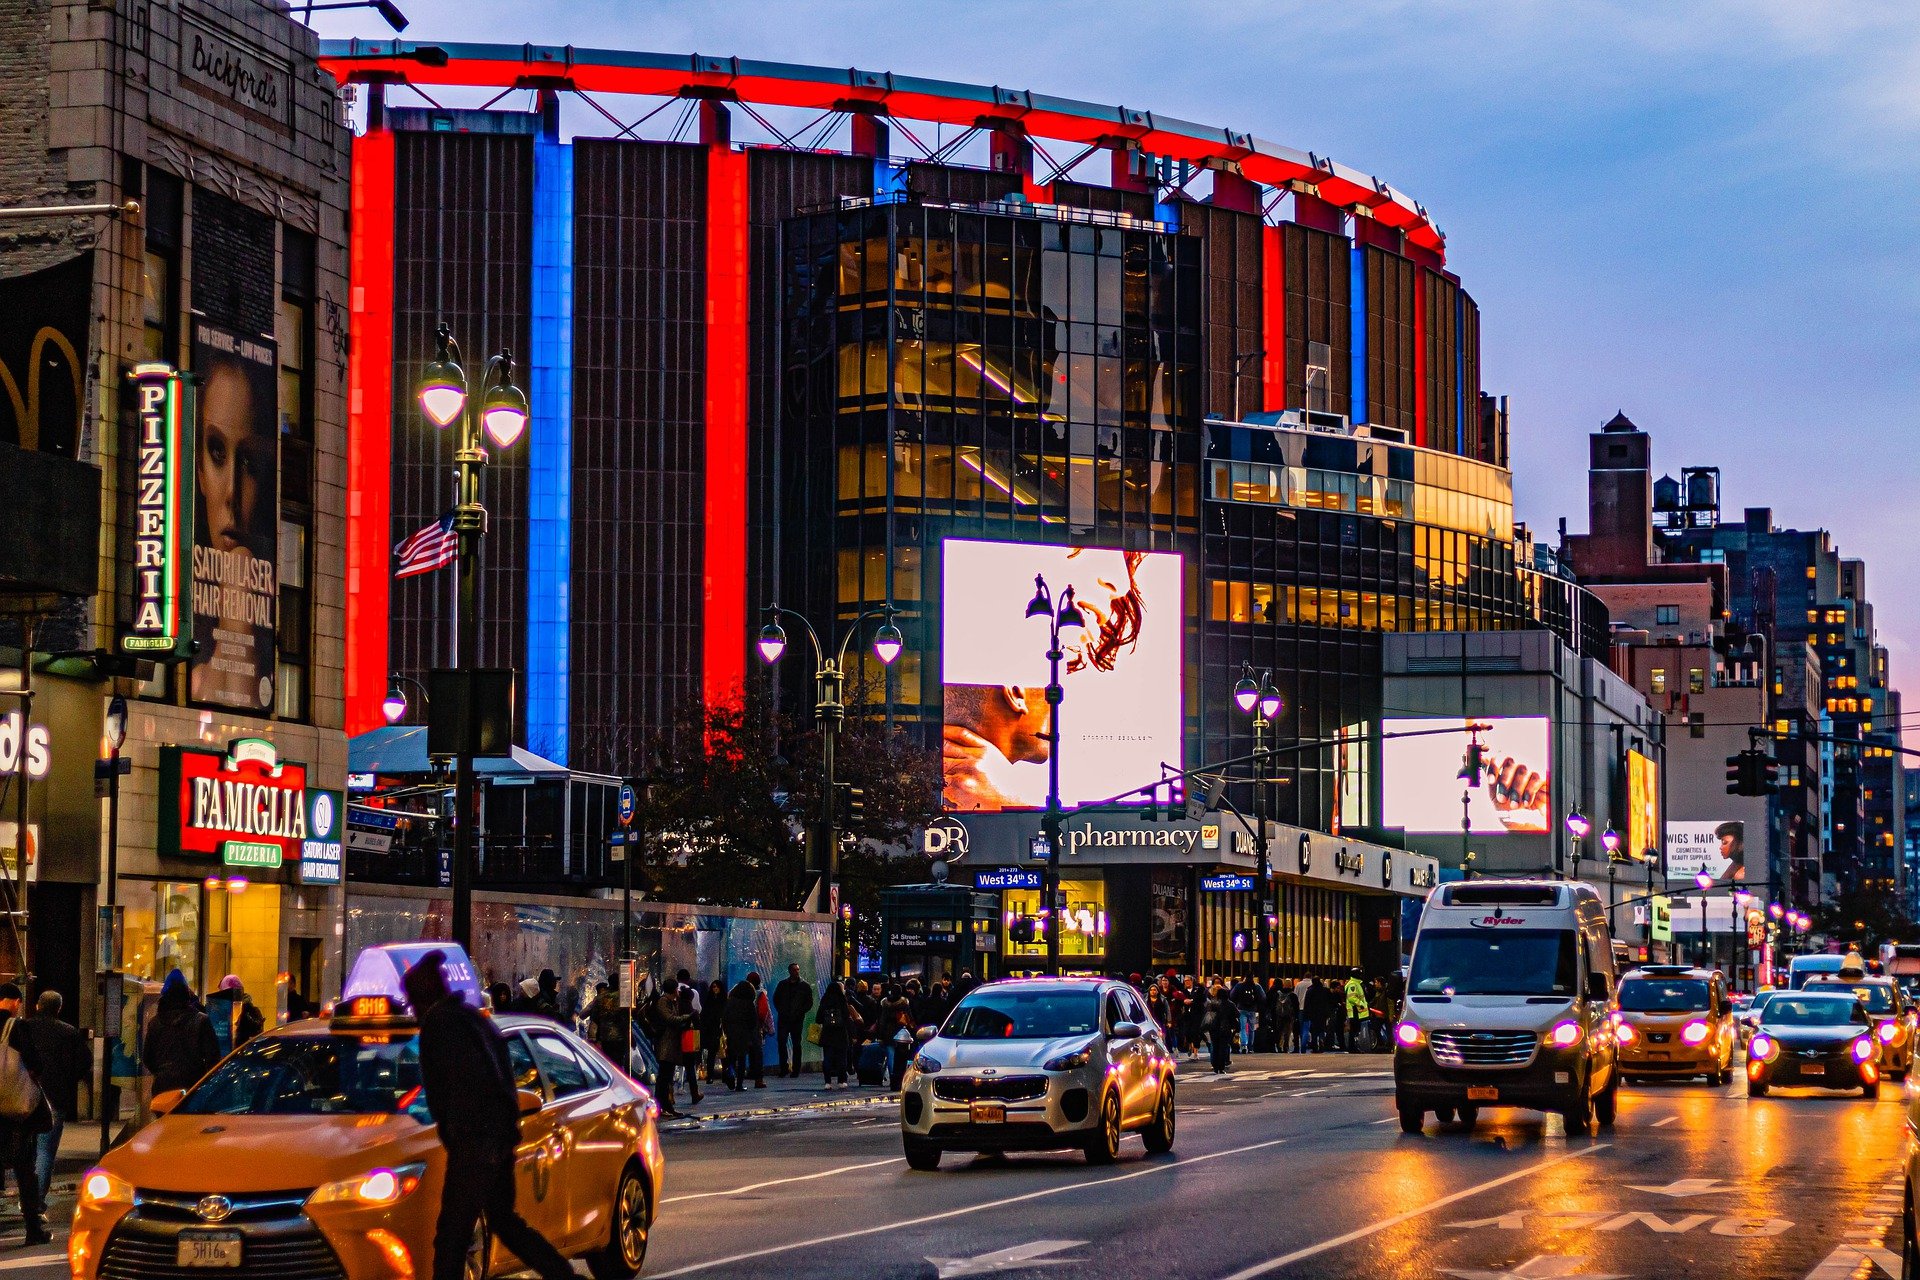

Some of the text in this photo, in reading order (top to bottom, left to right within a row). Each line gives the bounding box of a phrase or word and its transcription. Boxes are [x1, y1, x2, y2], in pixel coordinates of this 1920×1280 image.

[193, 35, 277, 108] Bickford's
[136, 386, 165, 628] PIZZERIA
[194, 544, 274, 596] SATORI LASER
[193, 581, 274, 630] HAIR REMOVAL
[129, 639, 168, 648] FAMIGLIA
[195, 776, 307, 840] FAMIGLIA
[924, 826, 969, 853] DR
[1069, 822, 1200, 855] pharmacy
[1667, 833, 1714, 844] WIGS HAIR
[228, 844, 277, 864] PIZZERIA
[303, 842, 341, 861] SATORI LASER
[303, 862, 340, 880] HAIR REMOVAL
[979, 873, 1038, 885] West 34th St
[1203, 879, 1251, 888] West 34th St
[1483, 916, 1526, 927] Ryder
[358, 998, 386, 1015] 5H16
